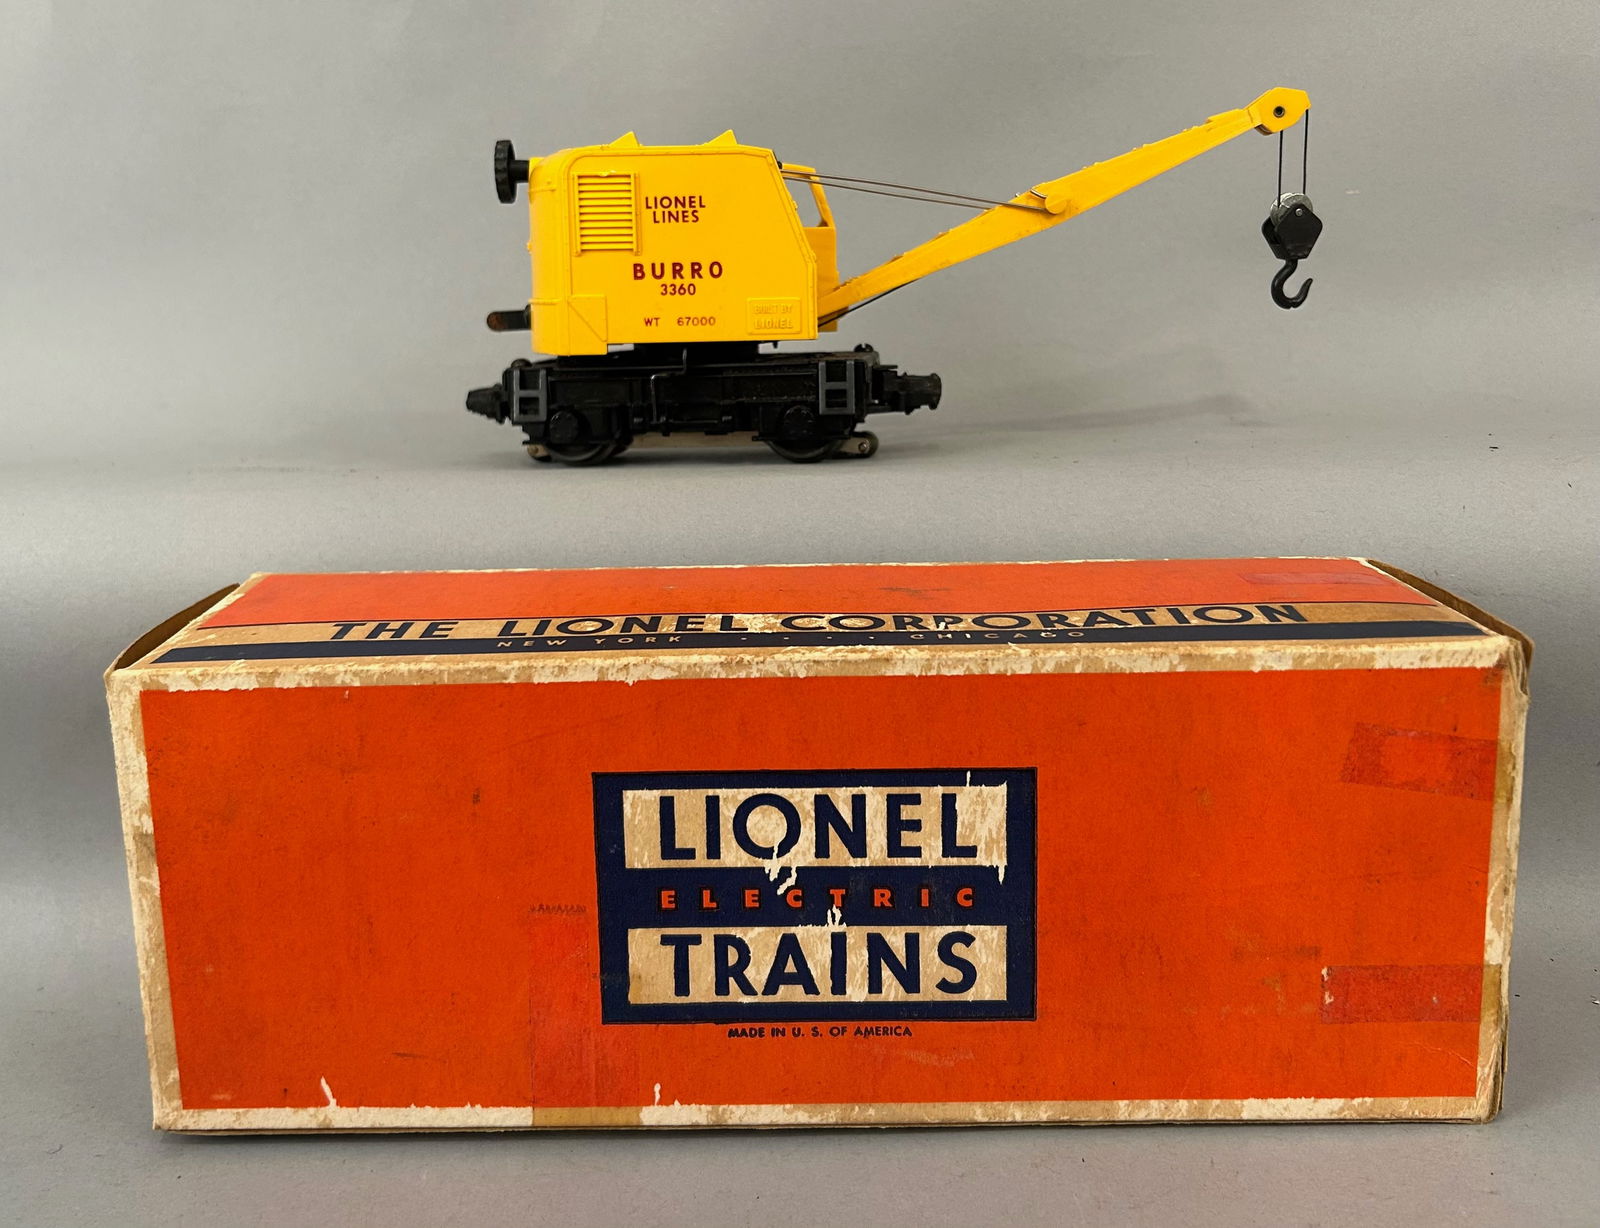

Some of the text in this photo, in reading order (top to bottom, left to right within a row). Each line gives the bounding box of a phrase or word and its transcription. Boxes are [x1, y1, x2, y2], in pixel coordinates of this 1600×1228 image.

[645, 195, 706, 209] LIONEL
[653, 210, 699, 224] LINES
[633, 261, 723, 280] BURRO
[660, 283, 696, 296] 3360
[754, 303, 793, 314] BUILT BY
[644, 316, 716, 327] WT 67000
[754, 318, 793, 330] LIONEL
[330, 606, 1308, 640] THE LIONEL CORPORATION
[497, 630, 1084, 648] NEW YORK CHICAGO
[659, 792, 978, 860] LIONEL
[660, 887, 976, 909] ELECTRIC
[660, 931, 978, 997] TRAINS
[727, 1025, 912, 1038] MADE IN U. S. OF AMERICA
